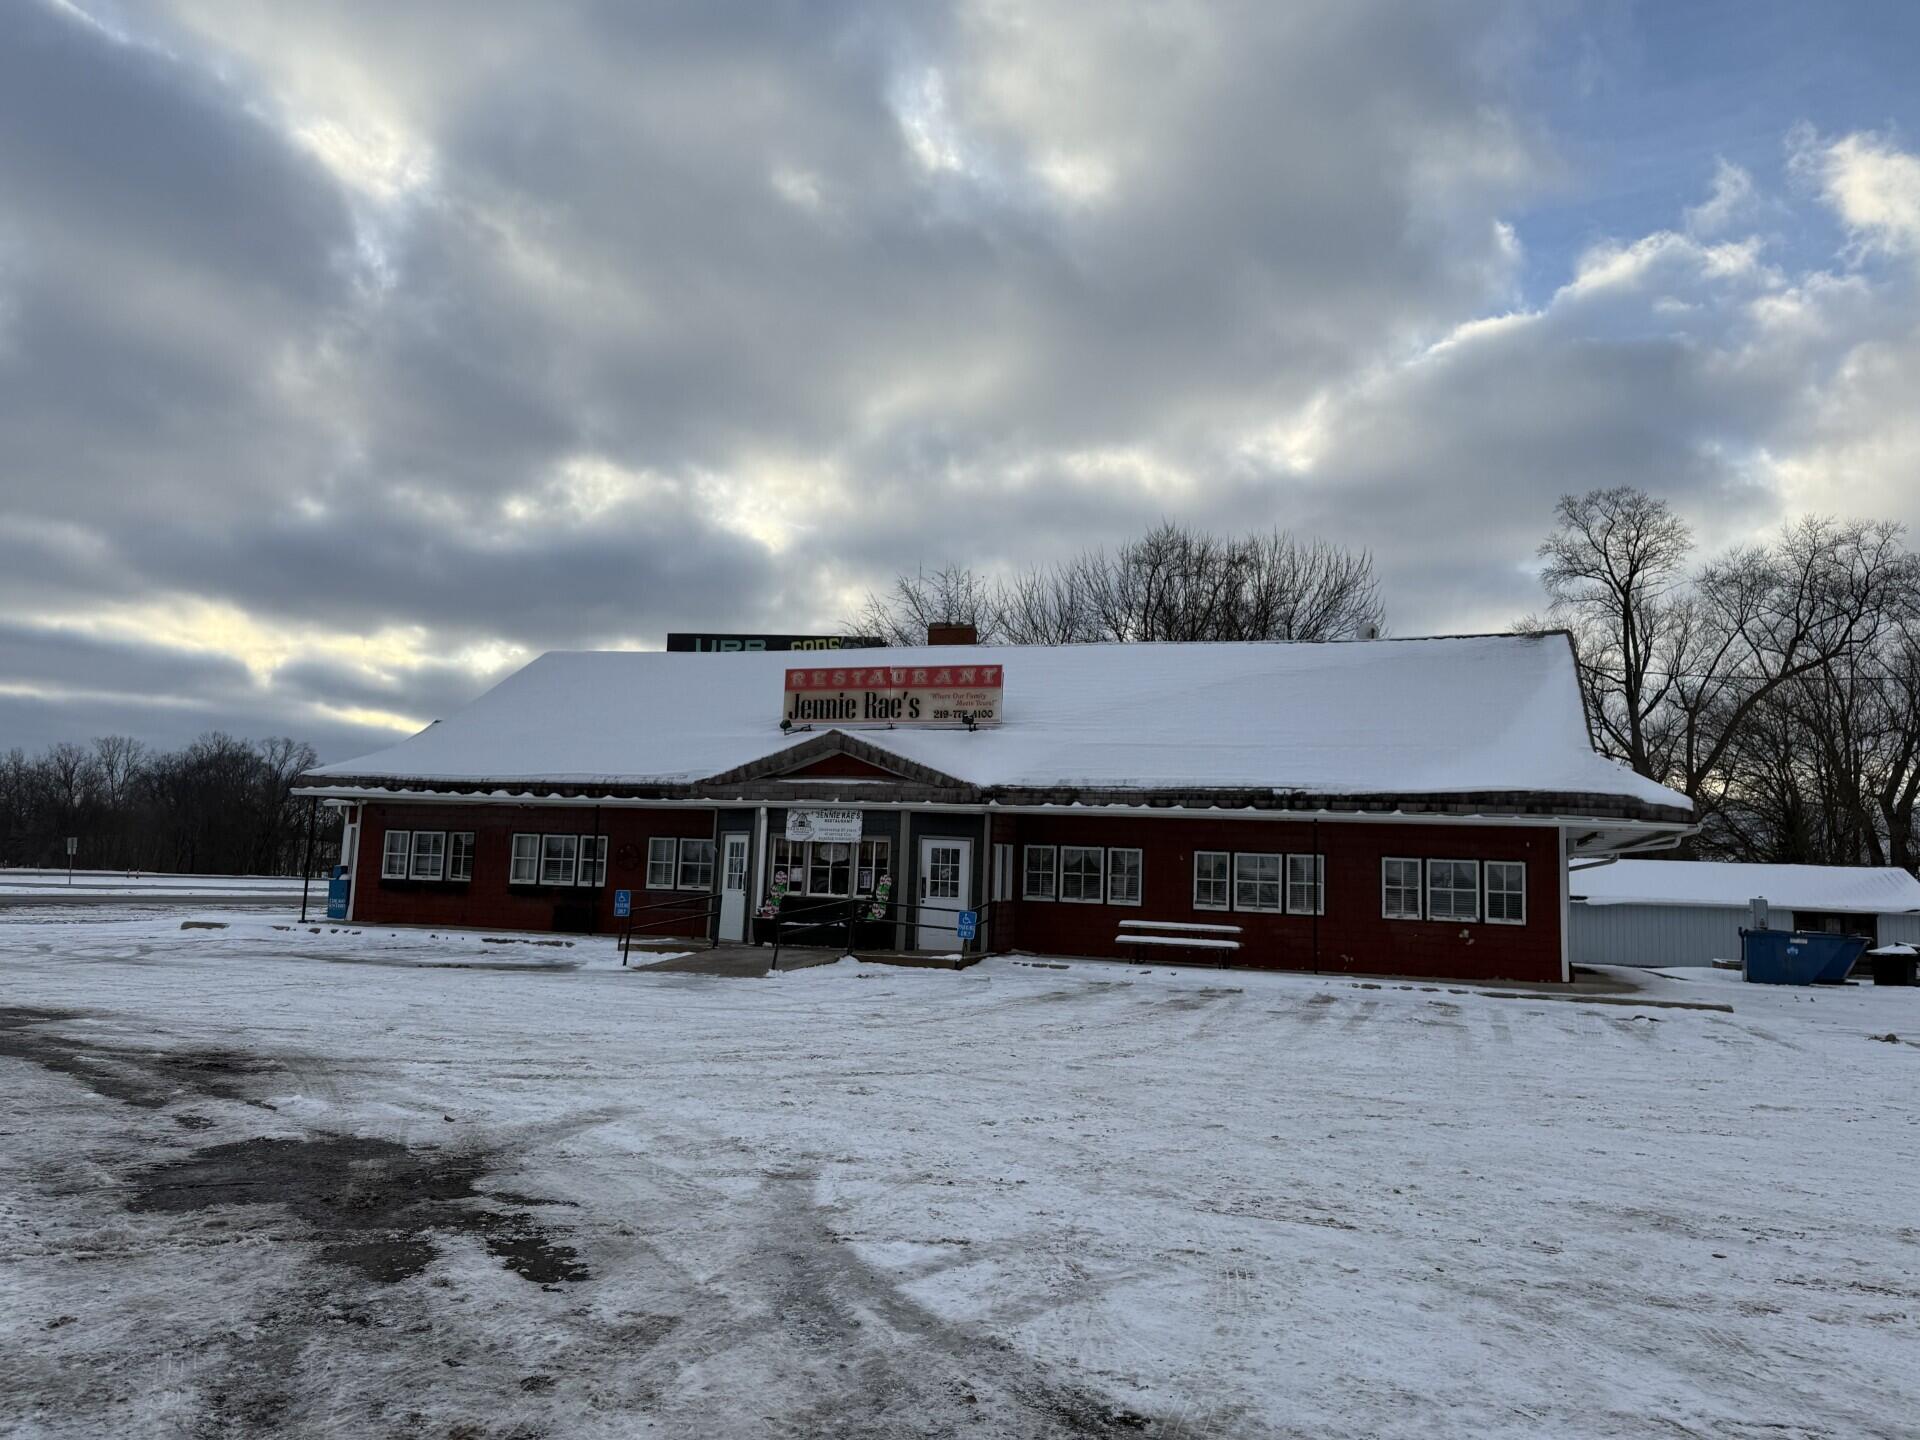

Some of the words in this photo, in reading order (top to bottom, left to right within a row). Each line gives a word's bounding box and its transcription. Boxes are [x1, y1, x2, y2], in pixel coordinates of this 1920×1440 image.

[792, 667, 998, 686] RESTAURANT
[788, 692, 857, 719] Jennie
[864, 691, 920, 719] Rae's
